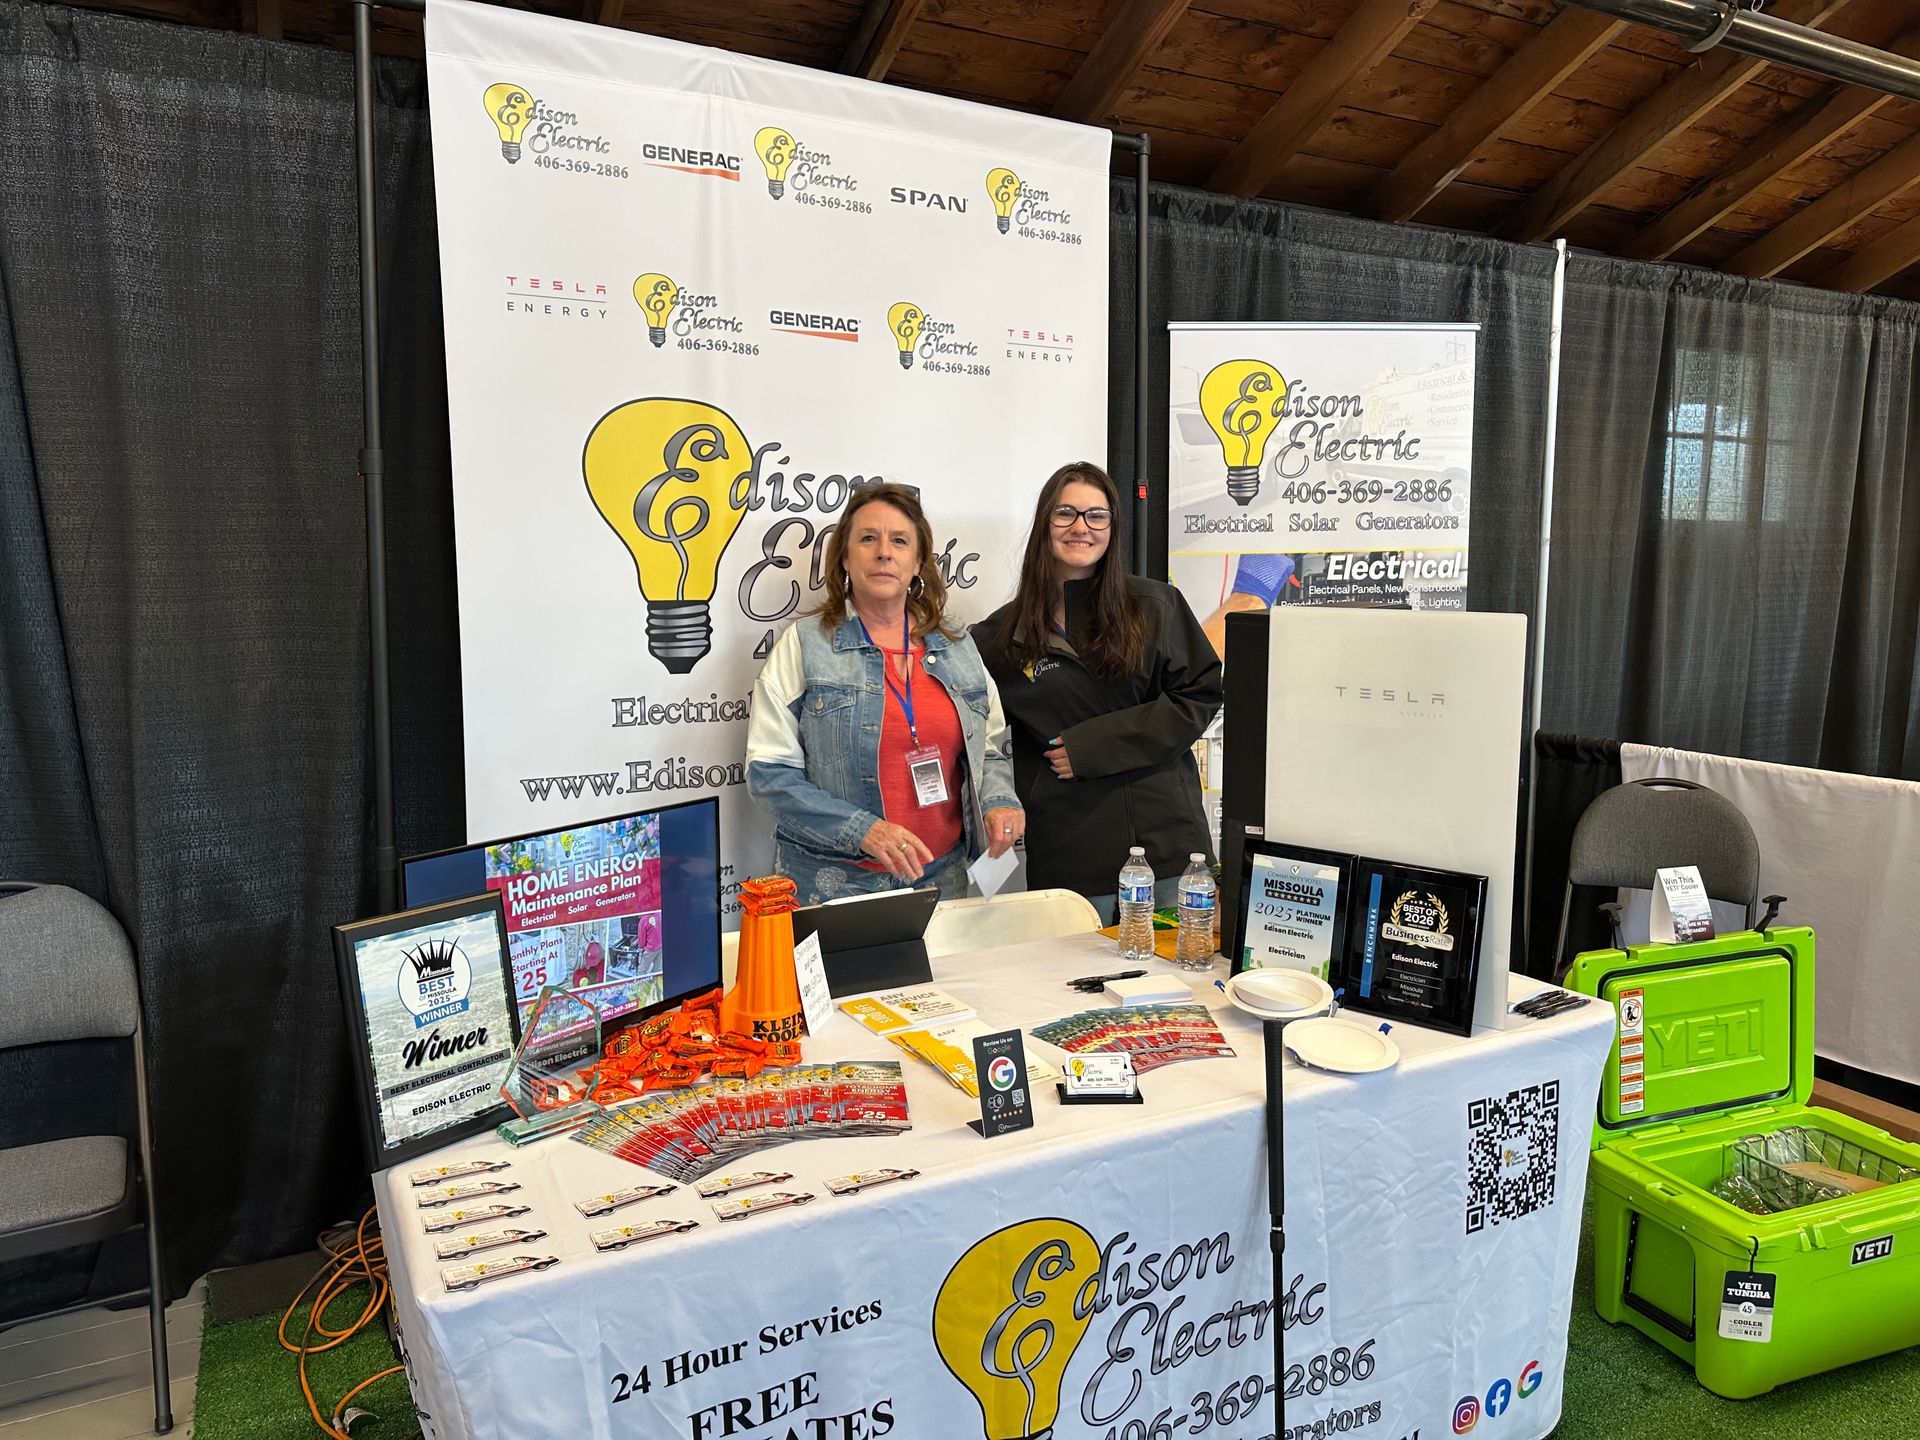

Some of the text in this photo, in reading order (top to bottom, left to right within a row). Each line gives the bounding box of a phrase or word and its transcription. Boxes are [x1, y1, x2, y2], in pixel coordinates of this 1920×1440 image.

[498, 91, 578, 126] Edison
[529, 123, 611, 153] Electric
[642, 143, 741, 171] GENERAC
[765, 135, 831, 166] Edison
[534, 155, 629, 179] 406-369-2886
[790, 163, 858, 191] Electric
[890, 187, 967, 213] SPAN
[995, 175, 1049, 203] Edison
[794, 192, 872, 214] 406-369-2886
[1015, 200, 1071, 225] Electric
[1018, 226, 1082, 246] 406-369-2886
[506, 276, 607, 295] TESLA
[645, 280, 717, 312] Edison
[507, 301, 607, 319] ENERGY
[672, 308, 743, 337] Electric
[769, 310, 859, 333] GENERAC
[897, 309, 955, 337] Edison
[677, 338, 760, 356] 406-369-2886
[919, 333, 978, 359] Electric
[1007, 329, 1074, 343] TESLA
[1006, 350, 1073, 364] ENERGY
[922, 361, 991, 377] 406-369-2886
[1222, 372, 1363, 435] Edison
[1275, 420, 1421, 478] Electric
[1282, 479, 1452, 505] 406-369-2886
[1184, 511, 1460, 534] Electrical Solar Generators
[738, 517, 981, 622] Elic
[1326, 552, 1463, 581] Electrical
[1308, 583, 1462, 595] Electrical Panels, New Construction,
[1429, 598, 1462, 608] Lighting,
[1034, 661, 1060, 676] Electric
[1335, 686, 1444, 706] TESLA
[507, 850, 648, 902] HOME ENERGY
[1663, 875, 1694, 886] Win This
[511, 874, 642, 917] Maintenance Plan
[1264, 878, 1324, 898] MISSOULA
[521, 891, 636, 927] Electrical Solar Generators
[1254, 902, 1331, 922] 2025 PLATINUM
[1402, 904, 1439, 917] BEST OF
[1404, 912, 1434, 926] 2026
[1264, 924, 1287, 935] Edison
[1287, 929, 1314, 940] Electric
[1296, 916, 1323, 927] WINNER
[1365, 908, 1377, 964] BENCHMARK
[511, 937, 563, 961] onthly Plans
[548, 951, 559, 961] At
[1268, 946, 1306, 960] Electrician
[1391, 953, 1439, 969] Edison Electric
[419, 975, 454, 995] BEST
[522, 966, 548, 992] 25
[1399, 973, 1426, 983] Electrician
[1399, 983, 1424, 994] Missoula
[427, 987, 457, 999] MISSOULA
[427, 995, 451, 1008] 2025
[880, 992, 905, 1001] ANY
[886, 991, 939, 1006] SERVICE
[419, 1001, 463, 1024] WINNER
[402, 1027, 488, 1069] Winner
[1648, 1008, 1761, 1068] YETI
[554, 1045, 588, 1063] Electric
[987, 1044, 1012, 1055] Google
[390, 1052, 504, 1095] BEST ELECTRICAL CONTRACTOR
[412, 1083, 492, 1116] EDISON ELECTRIC
[1854, 1238, 1890, 1261] YETI
[1727, 1288, 1771, 1299] TUNDRA
[1738, 1281, 1762, 1291] YETI
[981, 1231, 1235, 1378] Edison
[1742, 1305, 1752, 1314] 45
[1733, 1319, 1763, 1327] COOLER
[1744, 1329, 1762, 1337] NEED
[610, 1299, 882, 1403] 24 Hour Services
[1080, 1273, 1327, 1427] Electric
[686, 1371, 820, 1440] FREE
